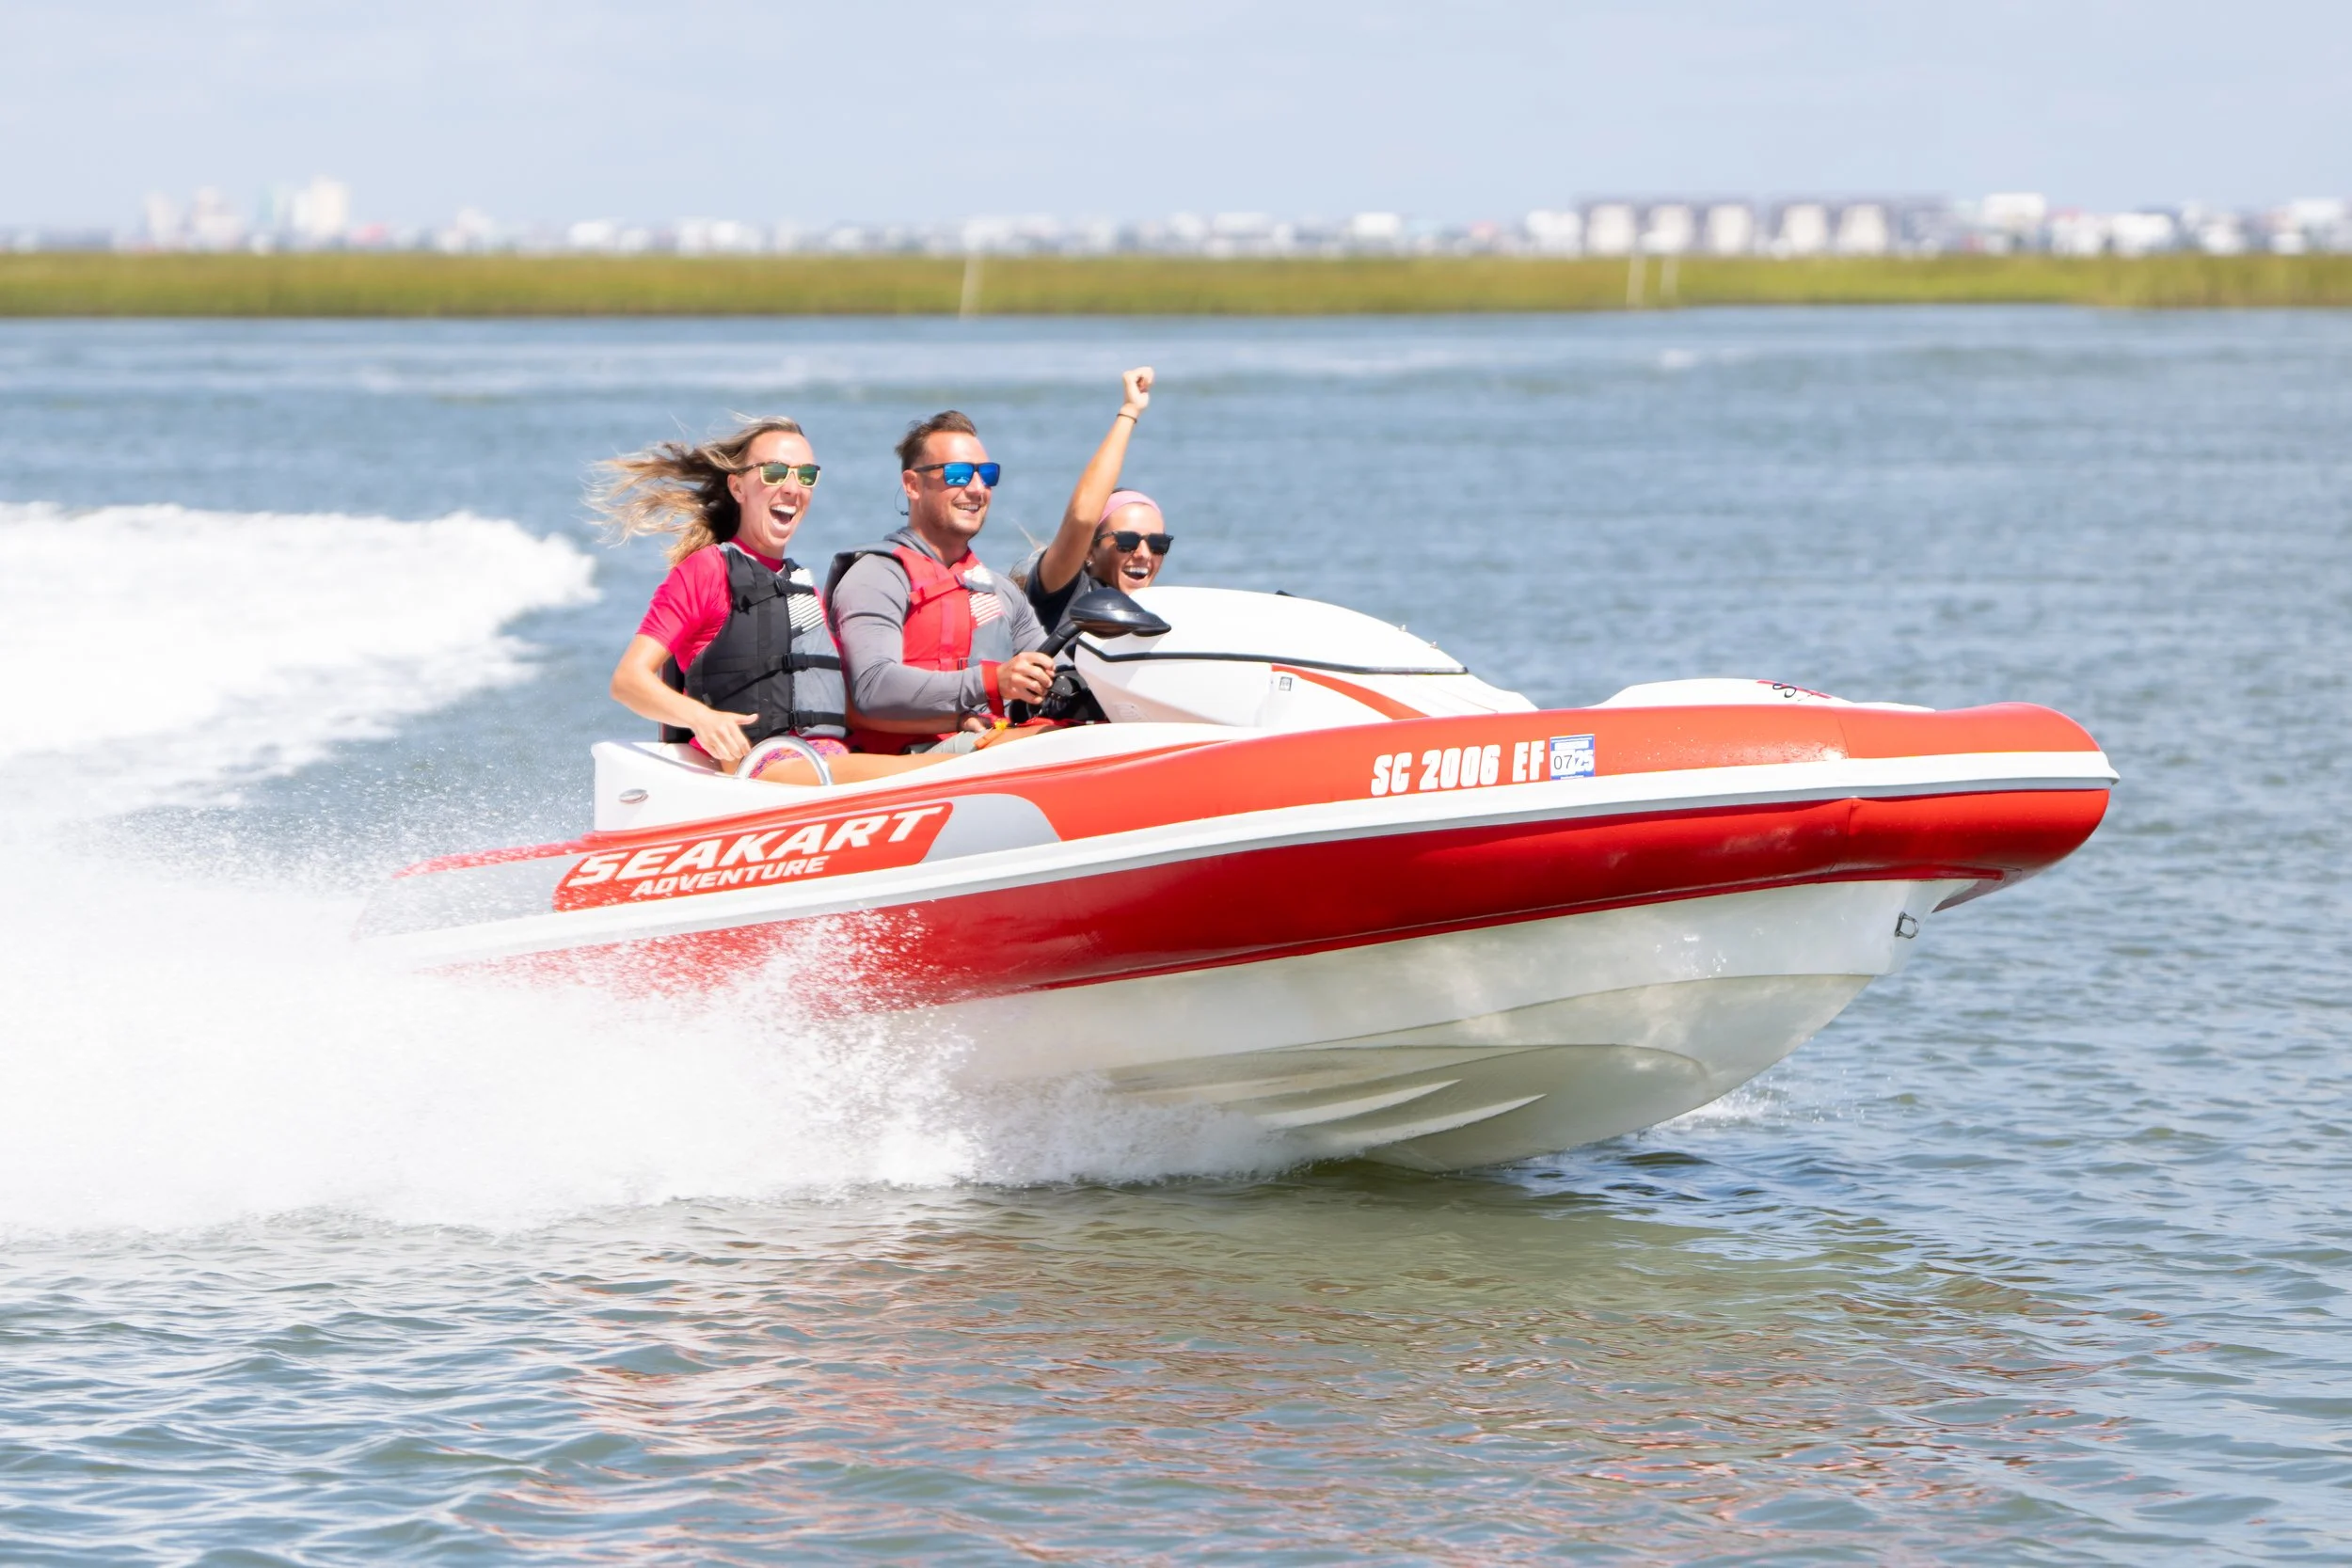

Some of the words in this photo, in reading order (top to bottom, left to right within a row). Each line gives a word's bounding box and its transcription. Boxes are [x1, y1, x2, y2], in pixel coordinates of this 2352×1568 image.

[1371, 752, 1412, 796] SC
[1419, 744, 1502, 790] 2006
[1512, 739, 1546, 783] EF
[568, 806, 943, 886] SEAKART
[631, 855, 830, 897] ADVENTURE
